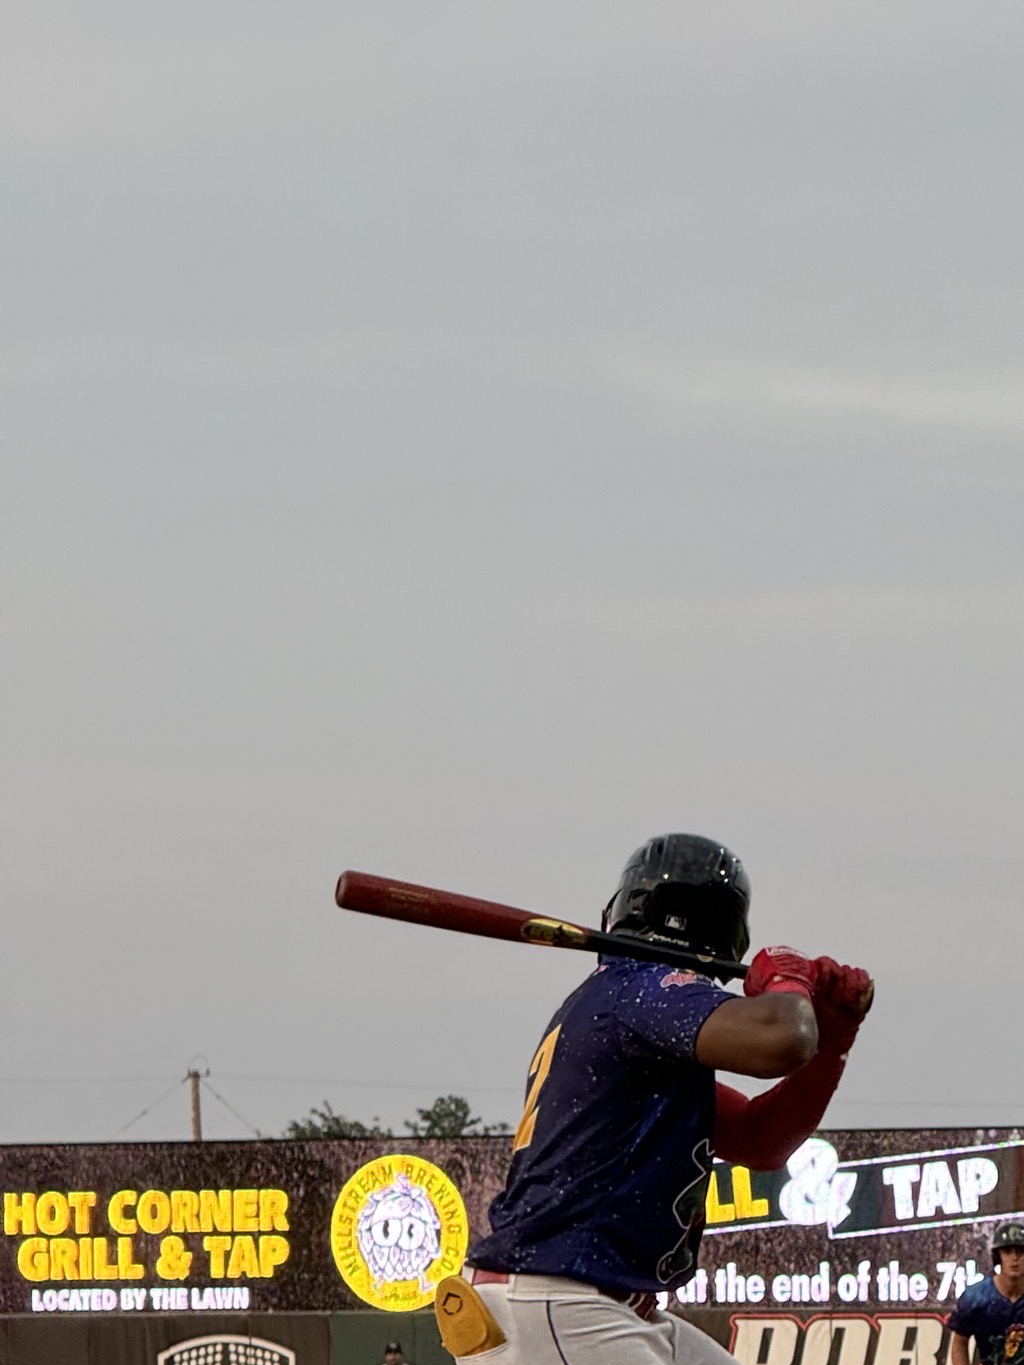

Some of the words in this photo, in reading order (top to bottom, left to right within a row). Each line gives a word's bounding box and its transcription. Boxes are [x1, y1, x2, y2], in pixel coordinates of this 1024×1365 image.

[779, 1138, 857, 1228] &
[882, 1157, 999, 1220] TAP
[3, 1191, 97, 1236] HOT
[108, 1189, 290, 1234] CORNER
[336, 1164, 393, 1276] MILLSTREAM
[404, 1163, 462, 1235] BREWING
[17, 1236, 145, 1282] GRILL
[156, 1235, 193, 1280] &
[203, 1235, 290, 1279] TAP
[715, 1261, 766, 1303] the
[772, 1260, 830, 1303] end
[837, 1259, 871, 1302] of
[876, 1260, 929, 1302] the
[31, 1288, 117, 1312] LOCATED
[120, 1288, 147, 1311] BY
[149, 1287, 189, 1310] THE
[191, 1286, 250, 1310] LAWN
